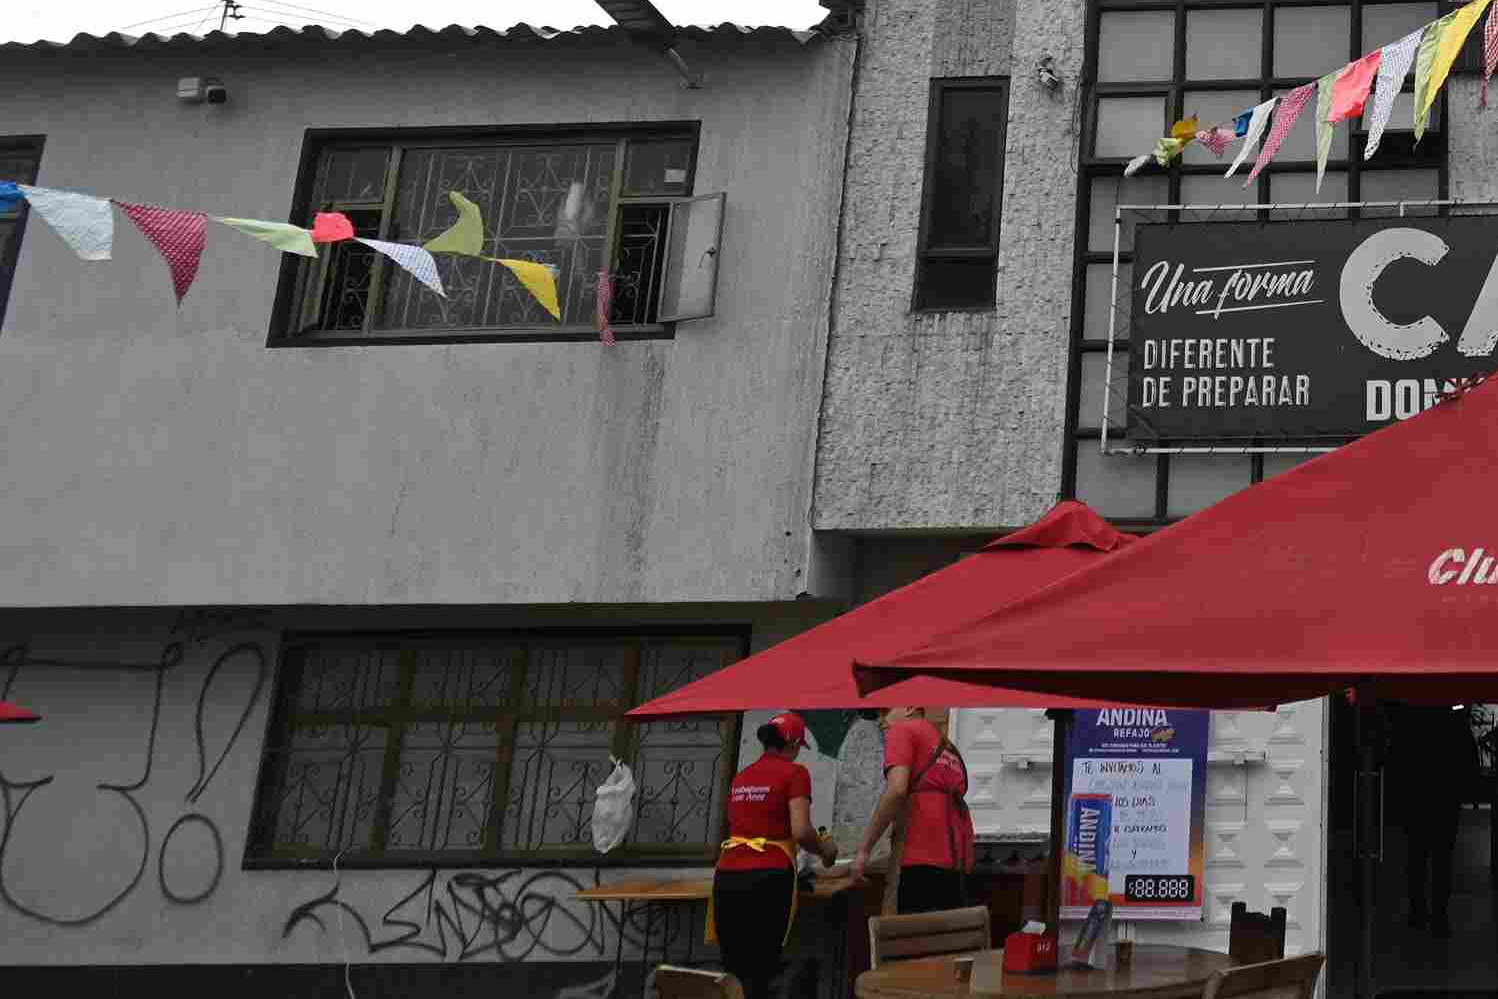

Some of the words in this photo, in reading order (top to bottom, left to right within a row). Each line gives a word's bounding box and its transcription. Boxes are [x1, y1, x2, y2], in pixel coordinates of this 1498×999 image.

[1141, 260, 1214, 315] Una
[1214, 269, 1315, 320] forma
[1143, 337, 1275, 370] DIFERENTE
[1142, 376, 1172, 408] DE
[1182, 374, 1311, 407] PREPARAR
[1096, 708, 1169, 726] ANDINA
[1113, 728, 1150, 739] REFAJO
